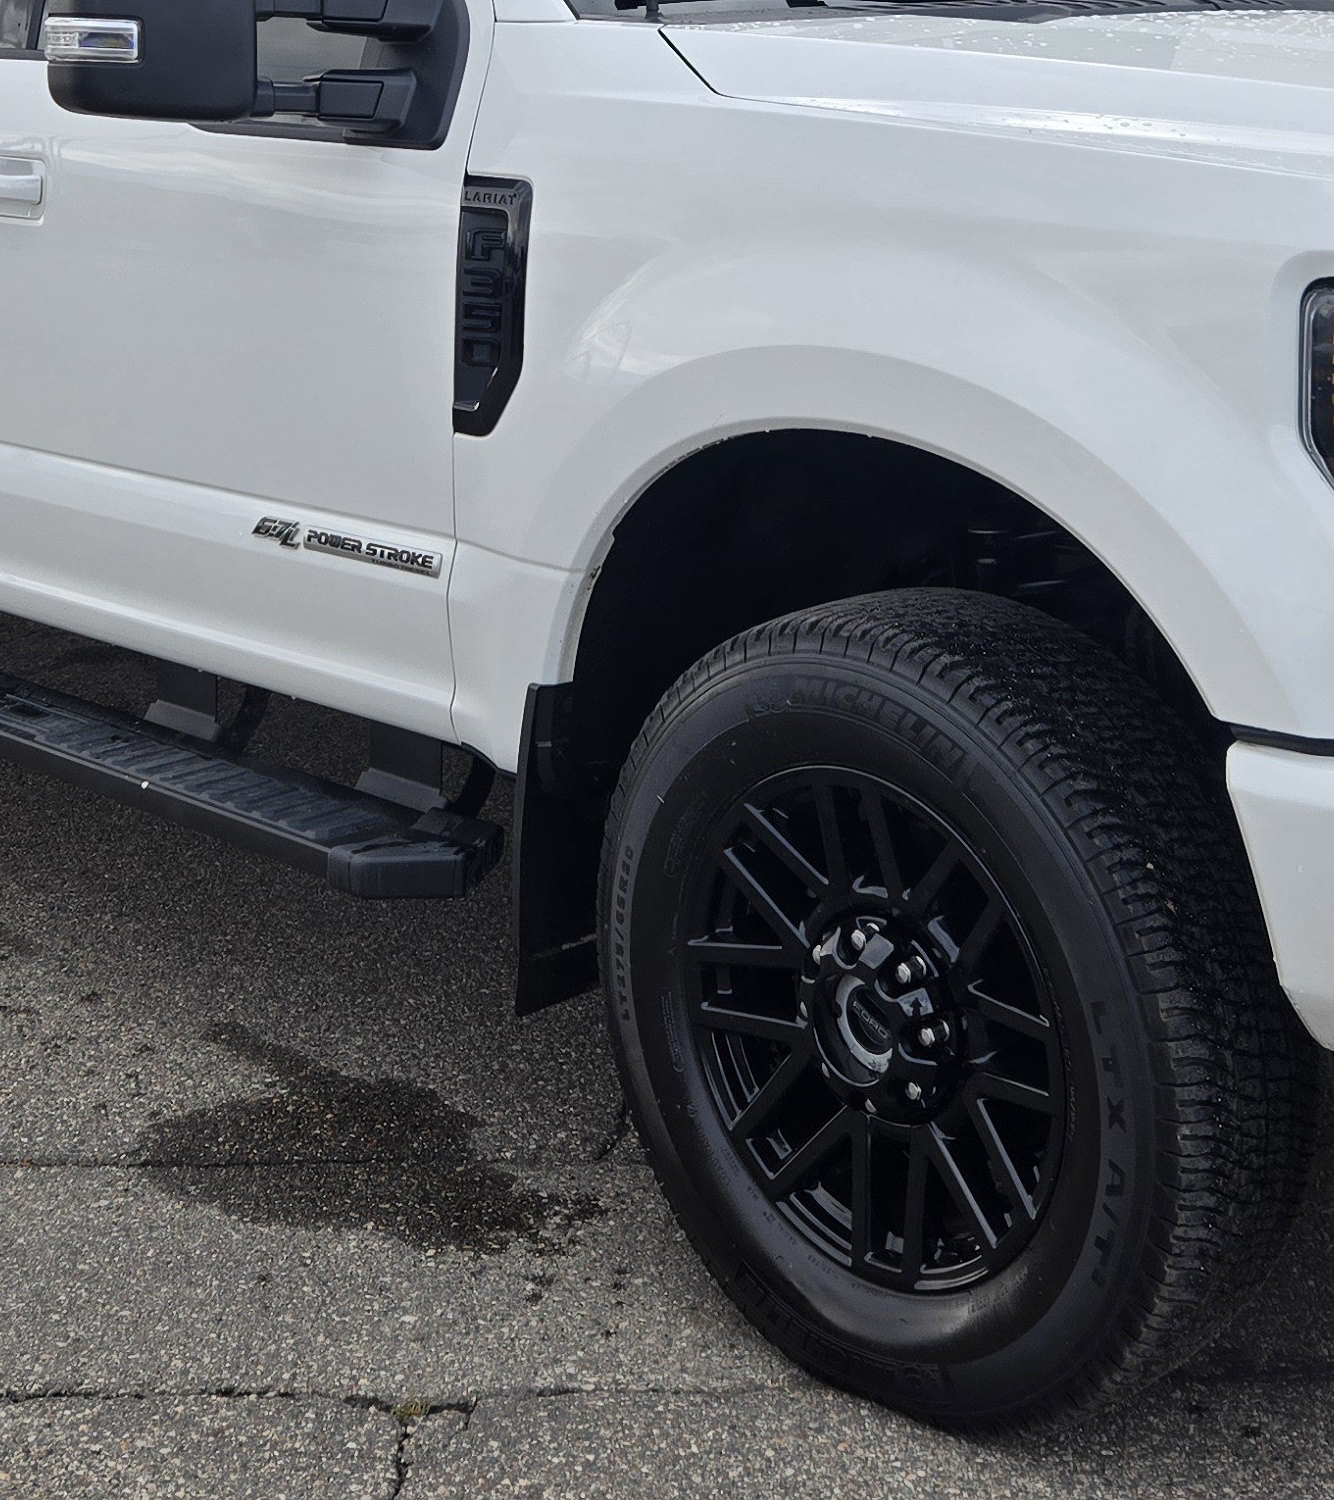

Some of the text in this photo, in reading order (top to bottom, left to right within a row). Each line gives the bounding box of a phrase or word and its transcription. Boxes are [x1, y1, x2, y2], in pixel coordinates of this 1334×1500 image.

[464, 191, 517, 206] LARIAT
[306, 529, 363, 554] POWER
[365, 542, 435, 570] STROKE
